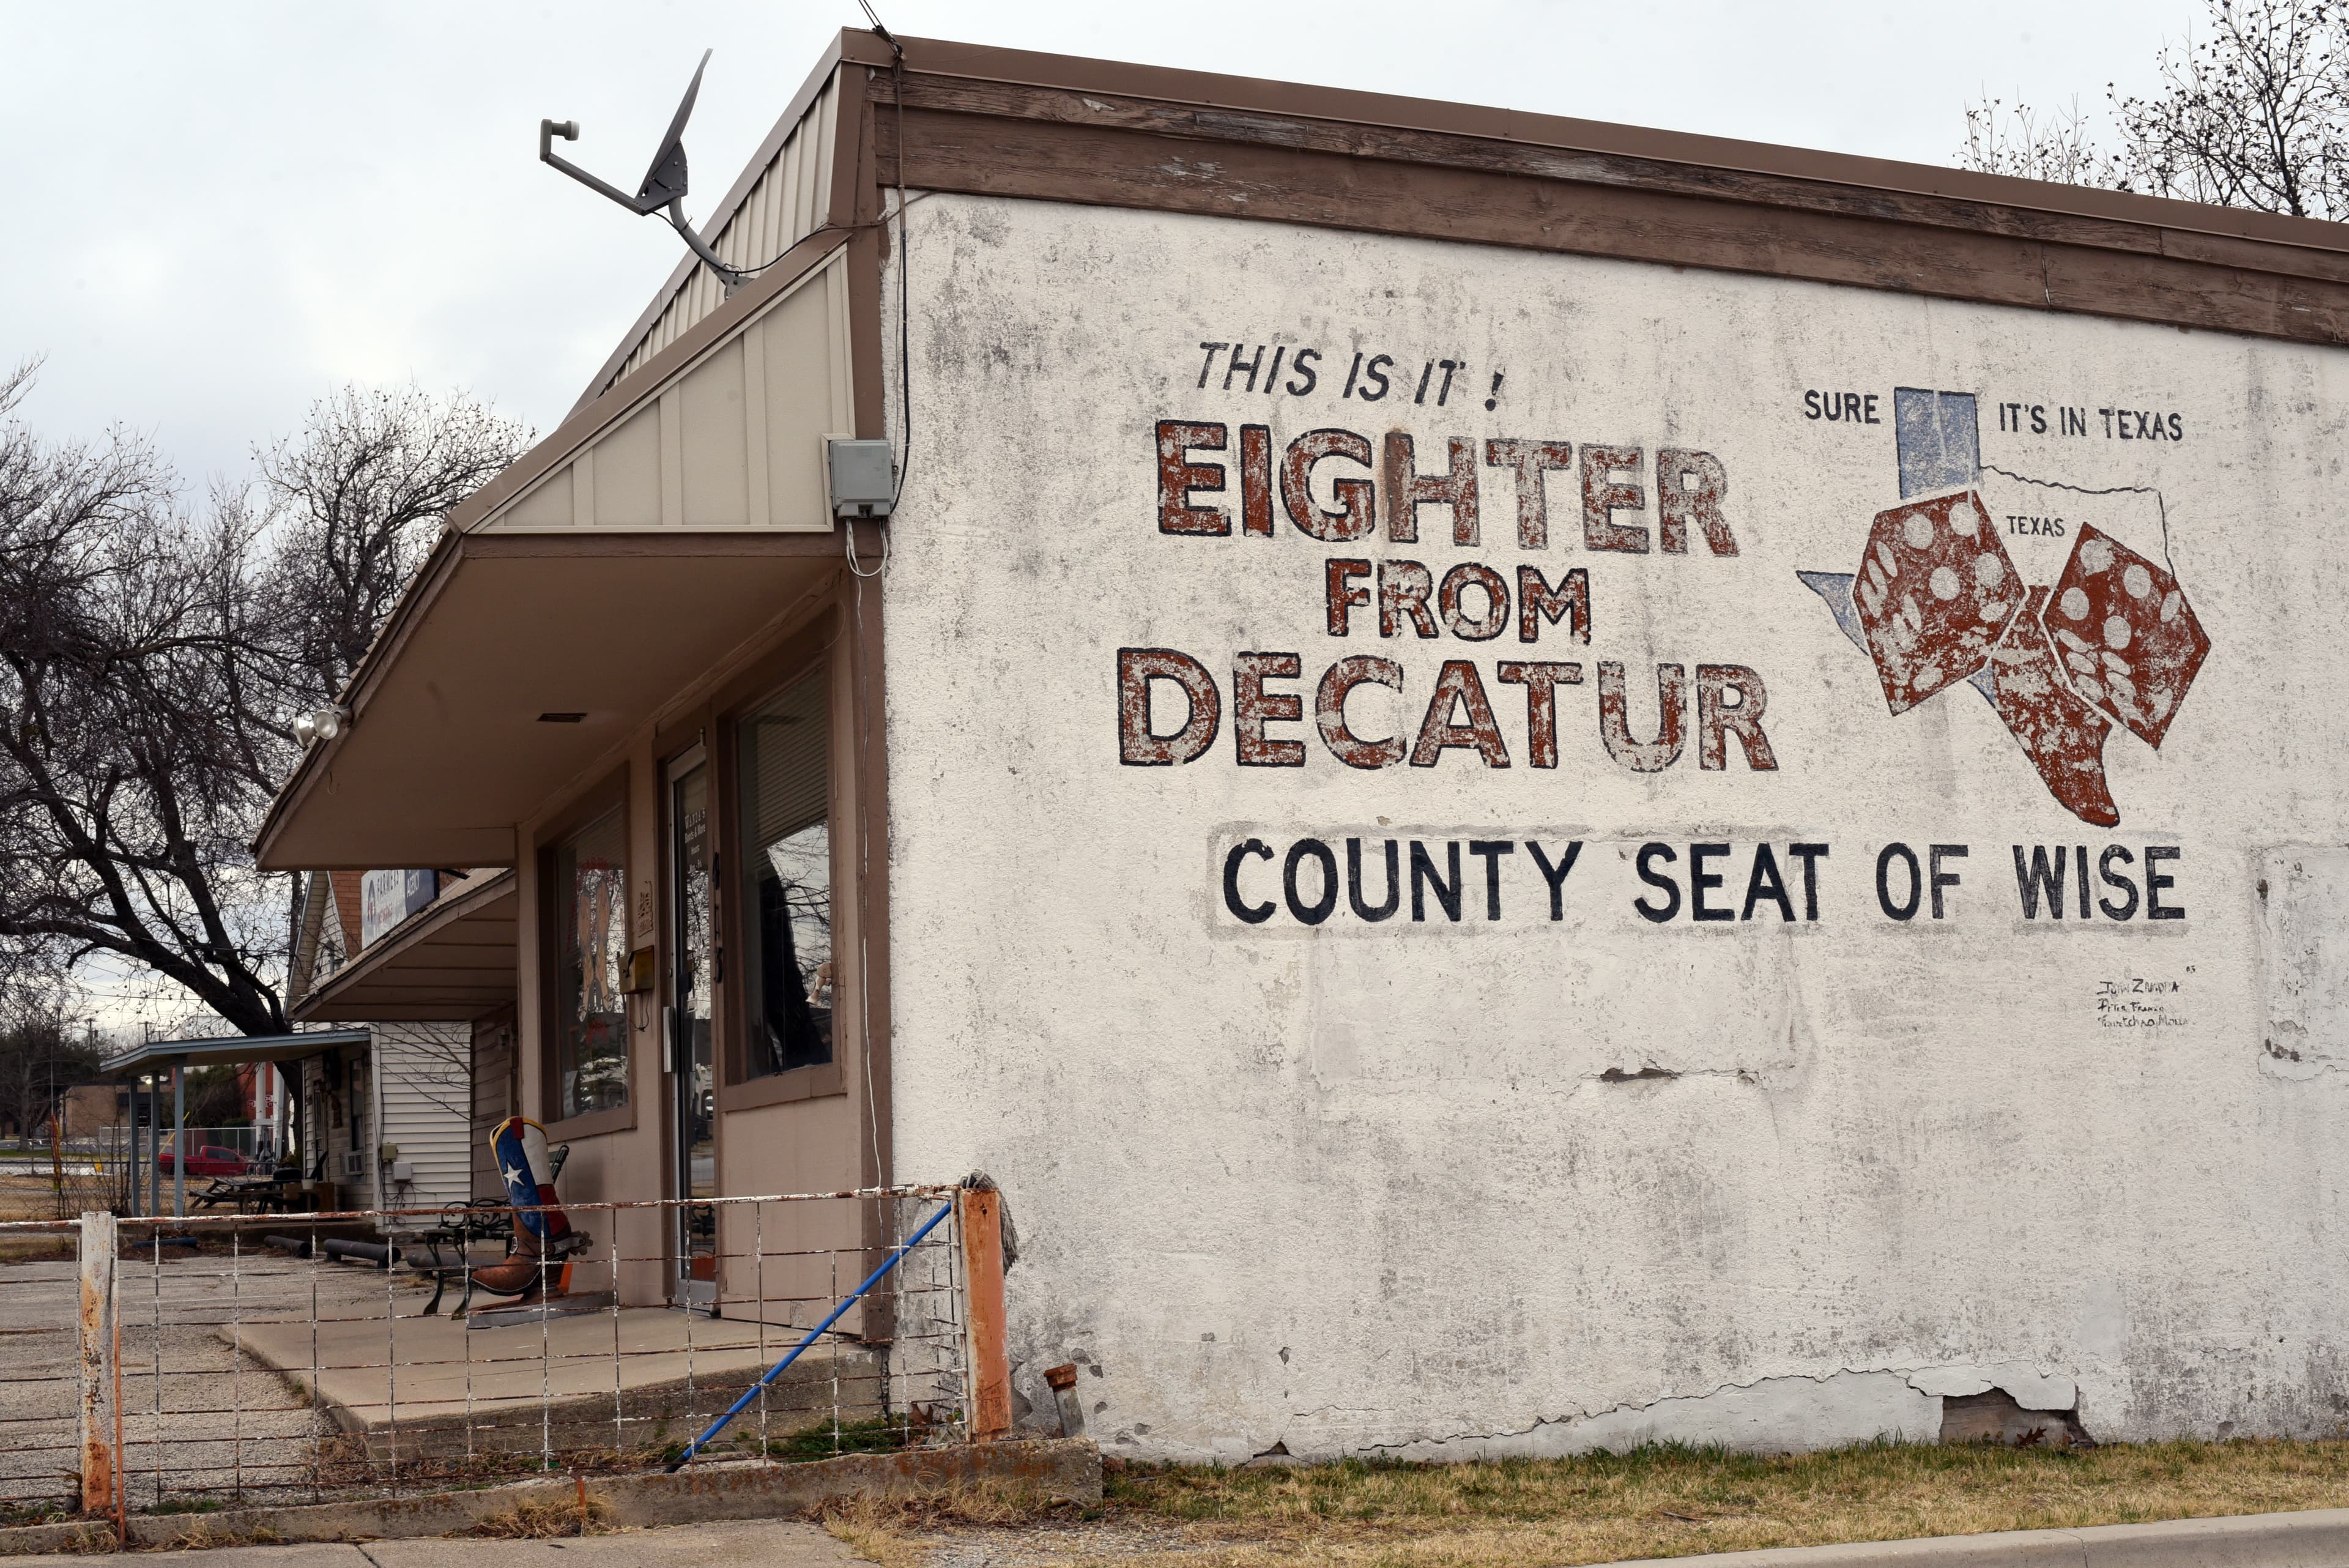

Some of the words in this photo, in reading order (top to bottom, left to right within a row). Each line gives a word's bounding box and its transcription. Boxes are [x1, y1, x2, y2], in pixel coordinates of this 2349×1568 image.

[1198, 343, 1321, 396] THIS
[1343, 353, 1393, 401] IS
[1805, 390, 1879, 423] SURE
[2000, 404, 2046, 433] IT'S
[2061, 407, 2085, 436] IN
[2099, 409, 2182, 440] TEXAS
[1155, 420, 1740, 558] EIGHTER
[2008, 516, 2063, 535] TEXAS
[1326, 559, 1590, 645] FROM
[1117, 647, 1778, 773] DECATUR
[377, 869, 399, 901] FARMERS
[1223, 838, 1583, 925] COUNTY
[1635, 842, 1828, 923] SEAT
[1877, 843, 1968, 921] OF
[2013, 845, 2184, 920] WISE
